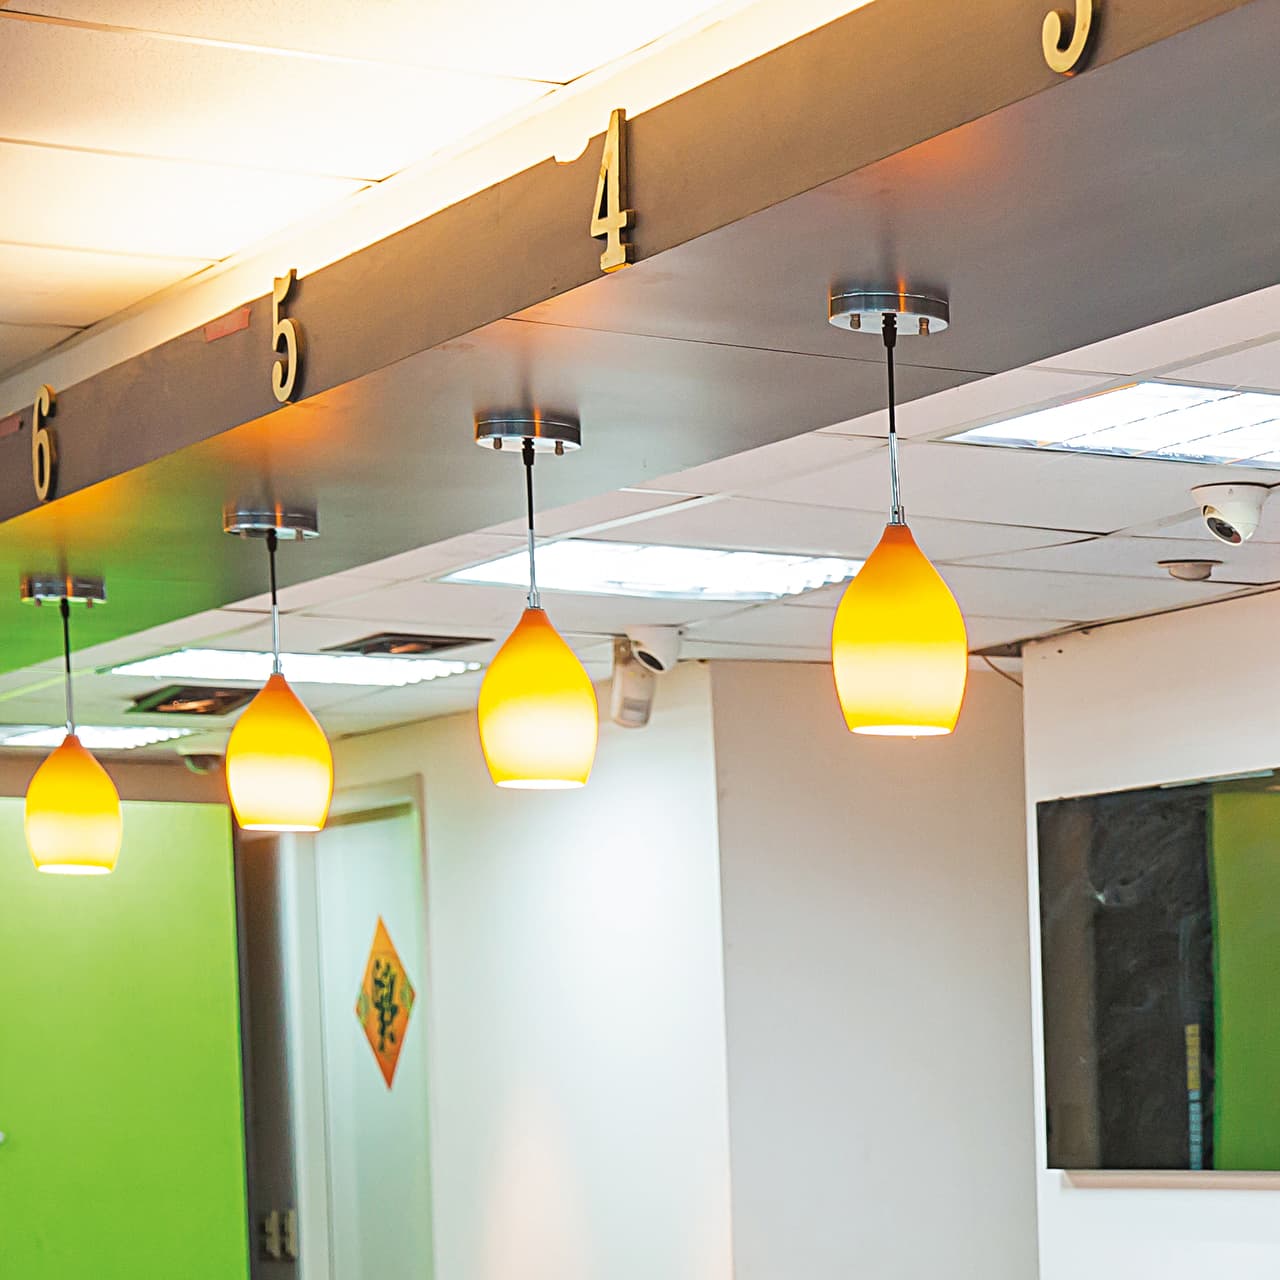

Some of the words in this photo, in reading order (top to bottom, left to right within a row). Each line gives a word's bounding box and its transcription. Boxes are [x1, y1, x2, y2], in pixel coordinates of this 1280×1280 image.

[590, 108, 635, 272] 4
[271, 268, 305, 403] 5
[30, 384, 57, 502] 6
